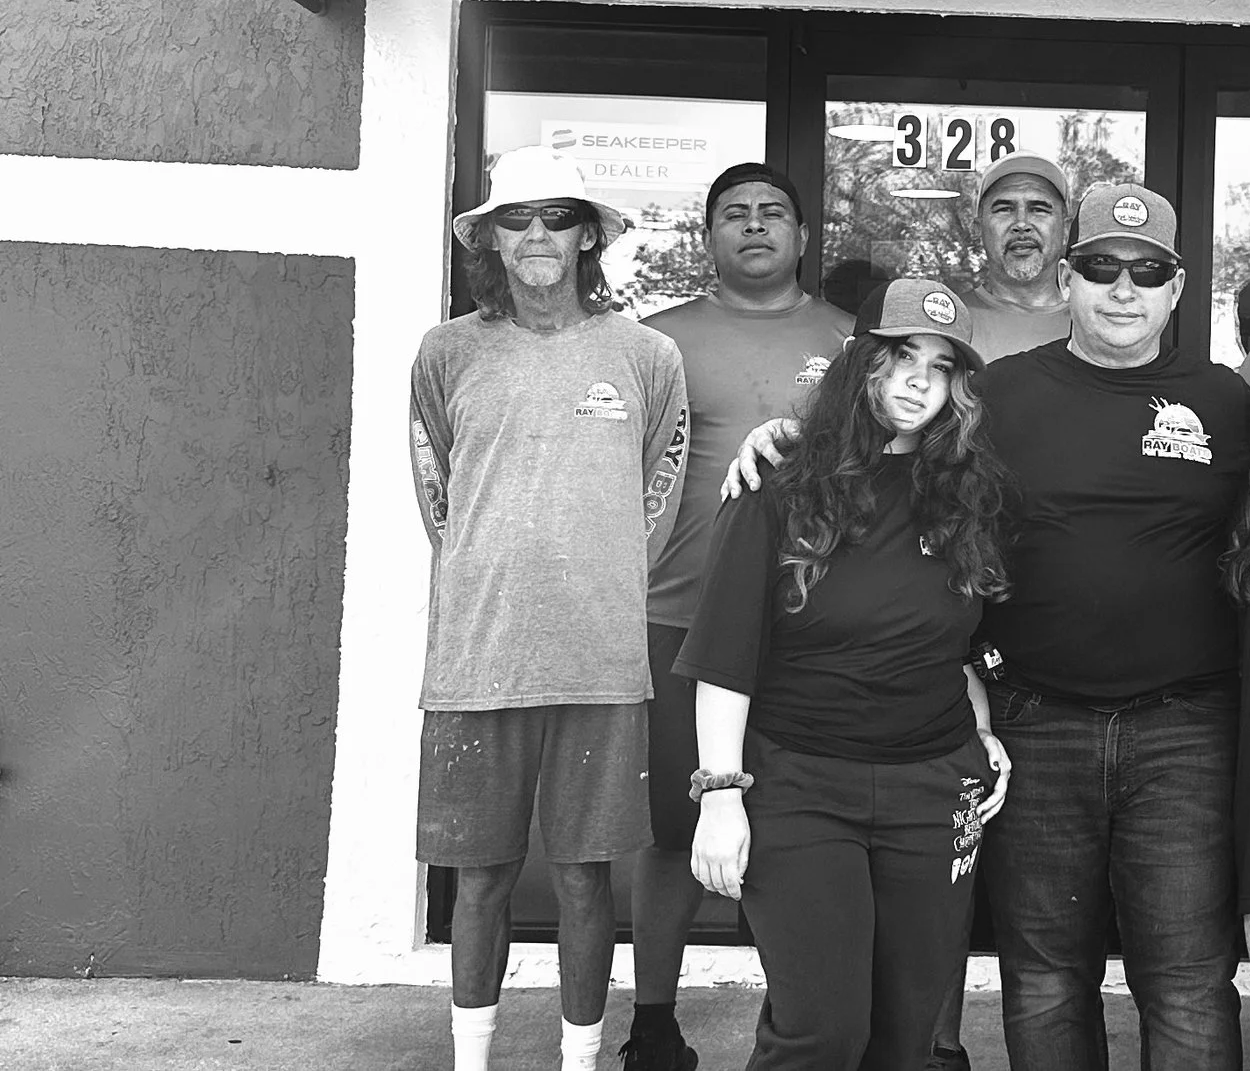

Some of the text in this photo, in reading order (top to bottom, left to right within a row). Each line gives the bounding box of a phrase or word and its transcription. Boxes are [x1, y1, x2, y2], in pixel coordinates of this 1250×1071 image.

[582, 135, 707, 150] SEAKEEPER
[595, 163, 668, 178] DEALER
[575, 408, 594, 416] RAY
[1143, 440, 1167, 450] RAY
